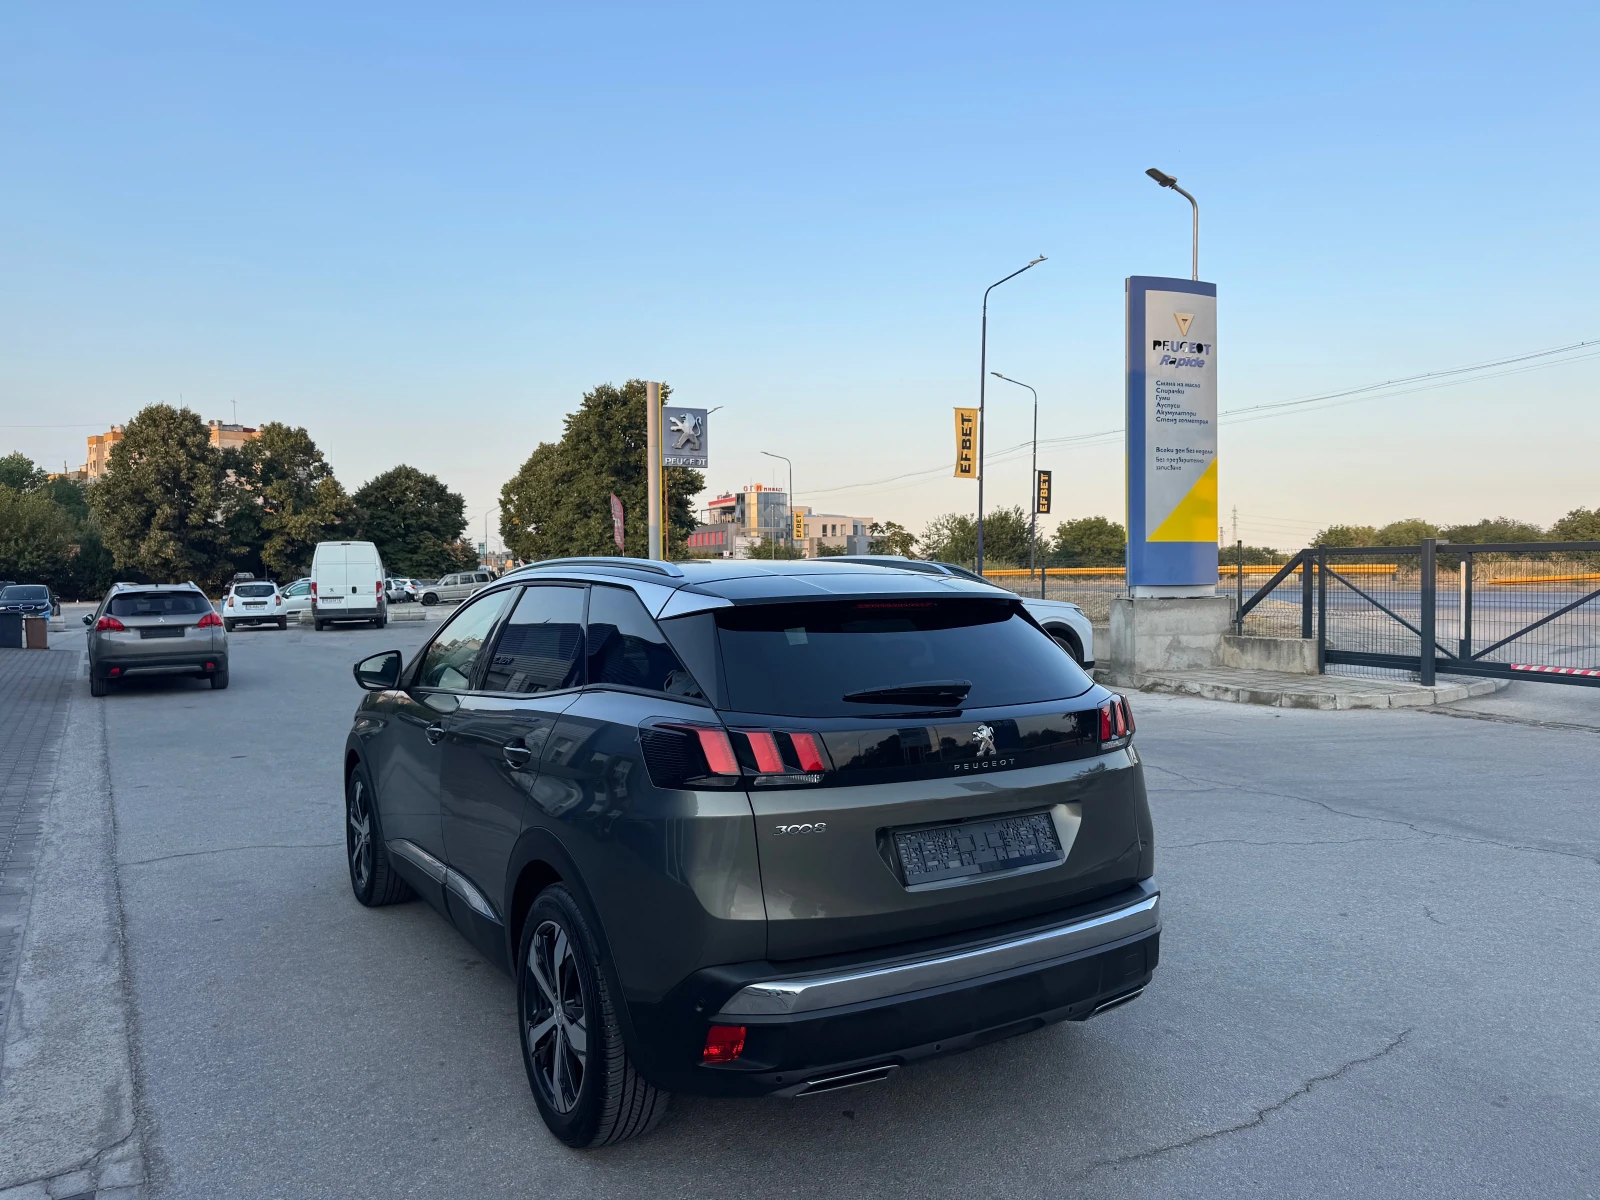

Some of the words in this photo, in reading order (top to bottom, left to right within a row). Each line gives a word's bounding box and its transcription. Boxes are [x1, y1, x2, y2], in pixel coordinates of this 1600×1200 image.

[1152, 340, 1211, 355] PEUGEOT
[1159, 354, 1205, 368] Rapide
[1155, 387, 1185, 395] Спирачки
[1155, 409, 1197, 418] Акумулатори
[1155, 416, 1177, 425] Стенд
[664, 457, 707, 466] PEUGEOT
[1039, 473, 1049, 512] EFBET
[953, 758, 1015, 771] PEUGEOT
[773, 822, 827, 836] 3008
